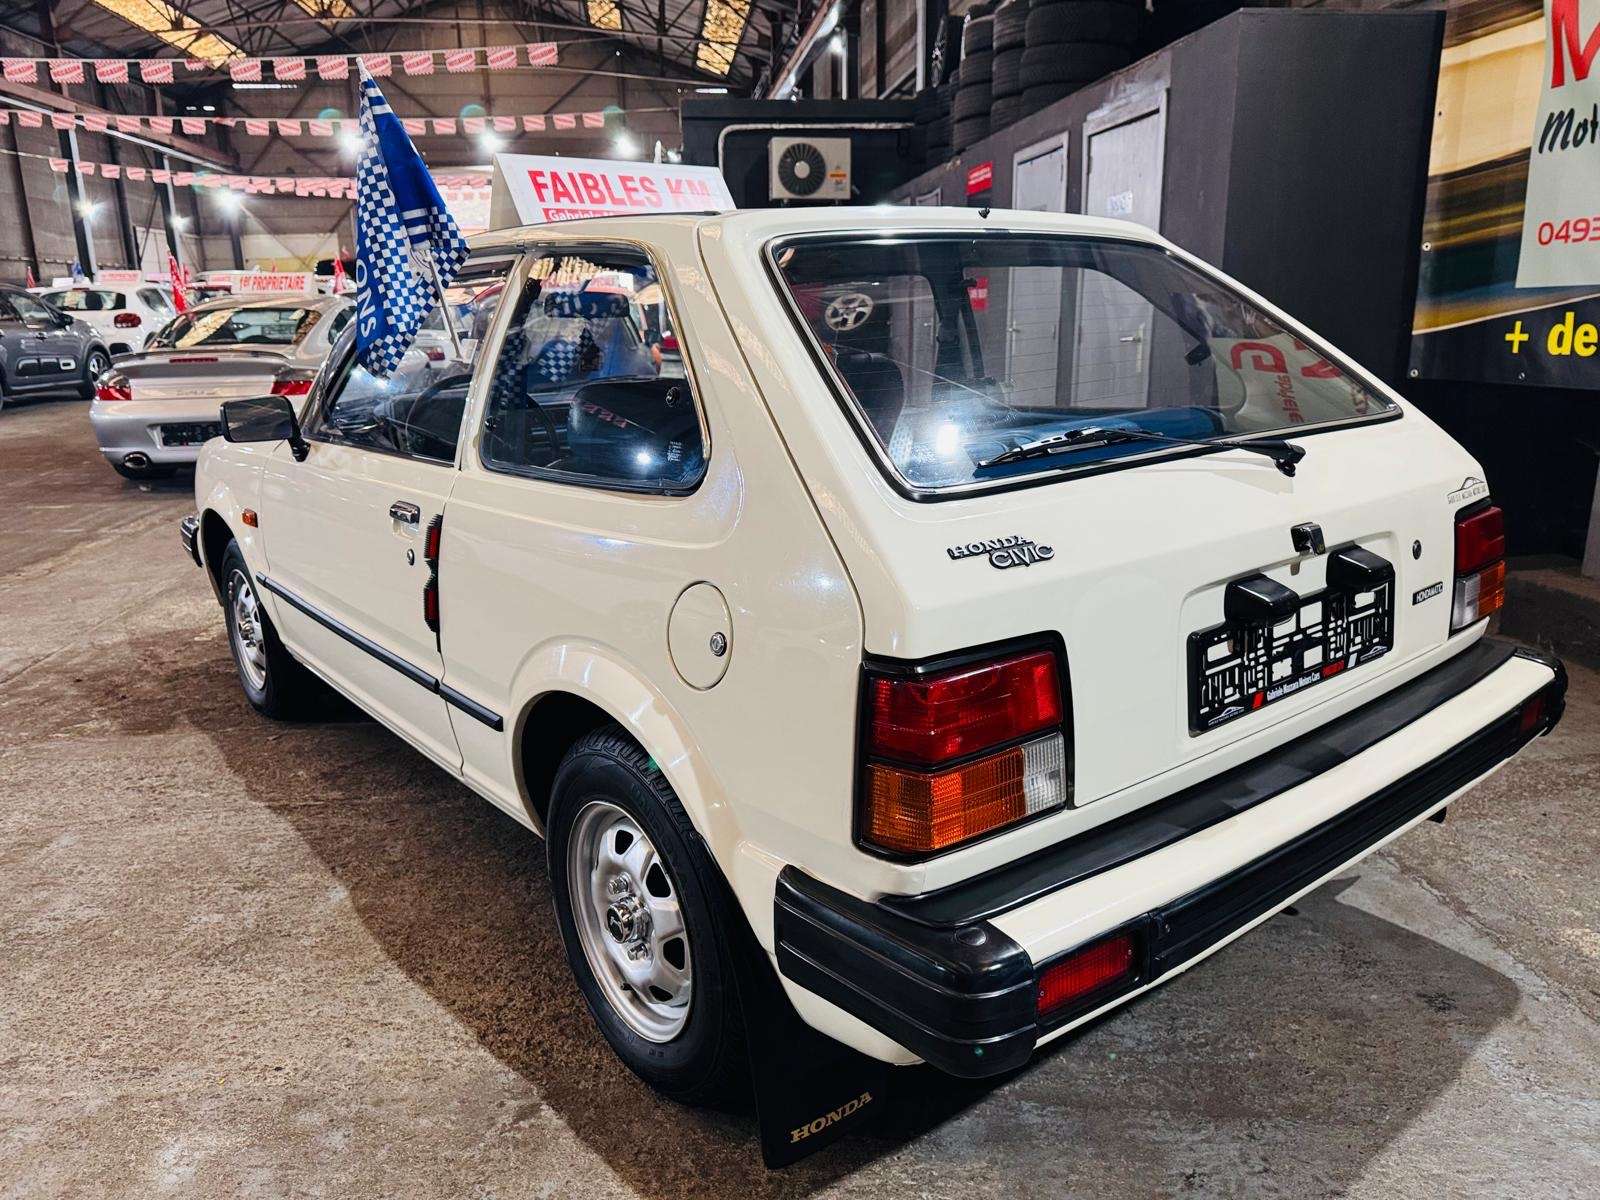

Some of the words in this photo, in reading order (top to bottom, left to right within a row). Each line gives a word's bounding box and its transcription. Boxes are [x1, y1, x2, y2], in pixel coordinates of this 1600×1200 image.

[527, 169, 663, 208] FAIBLES
[252, 275, 305, 291] PROPRIETAIRE
[1547, 311, 1599, 357] de
[948, 535, 1035, 560] HONDA
[989, 543, 1056, 569] CIVIC
[790, 1091, 873, 1144] HONDA
